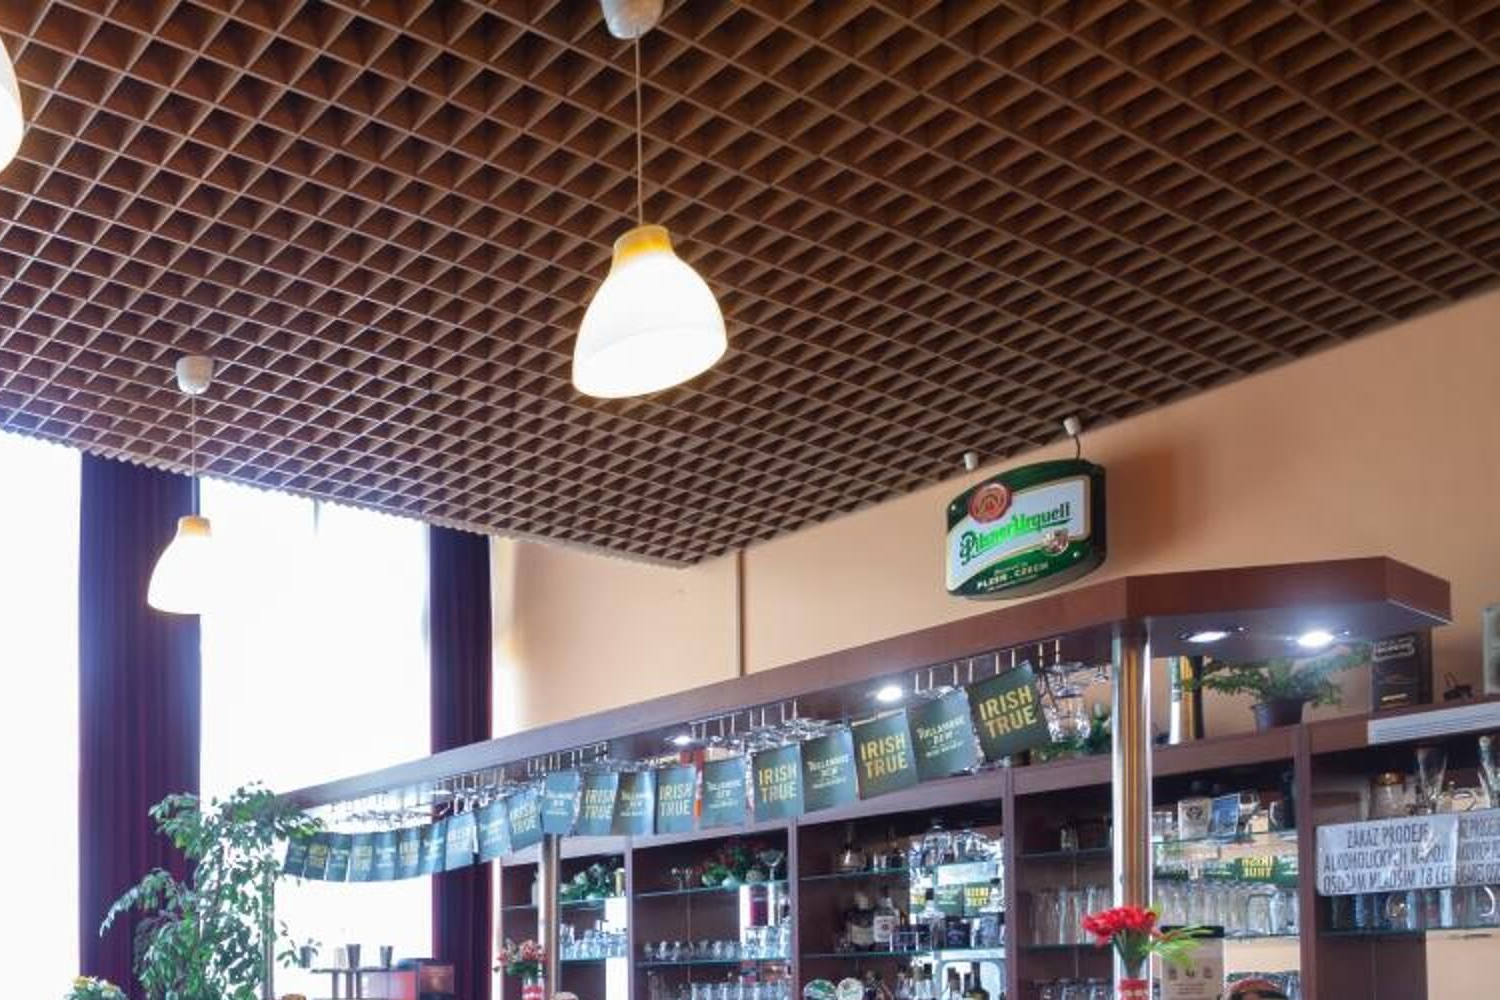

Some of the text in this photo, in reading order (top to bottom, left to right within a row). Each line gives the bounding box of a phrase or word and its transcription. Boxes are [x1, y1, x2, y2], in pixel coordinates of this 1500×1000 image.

[959, 522, 1013, 566] Pilsner
[1012, 501, 1072, 531] Urquell
[979, 685, 1033, 721] IRISH
[985, 706, 1037, 738] TRUE
[861, 733, 905, 760] IRISH
[758, 762, 797, 785] IRISH
[865, 752, 909, 779] TRUE
[660, 783, 693, 800] IRISH
[761, 781, 797, 802] TRUE
[661, 799, 692, 816] TRUE
